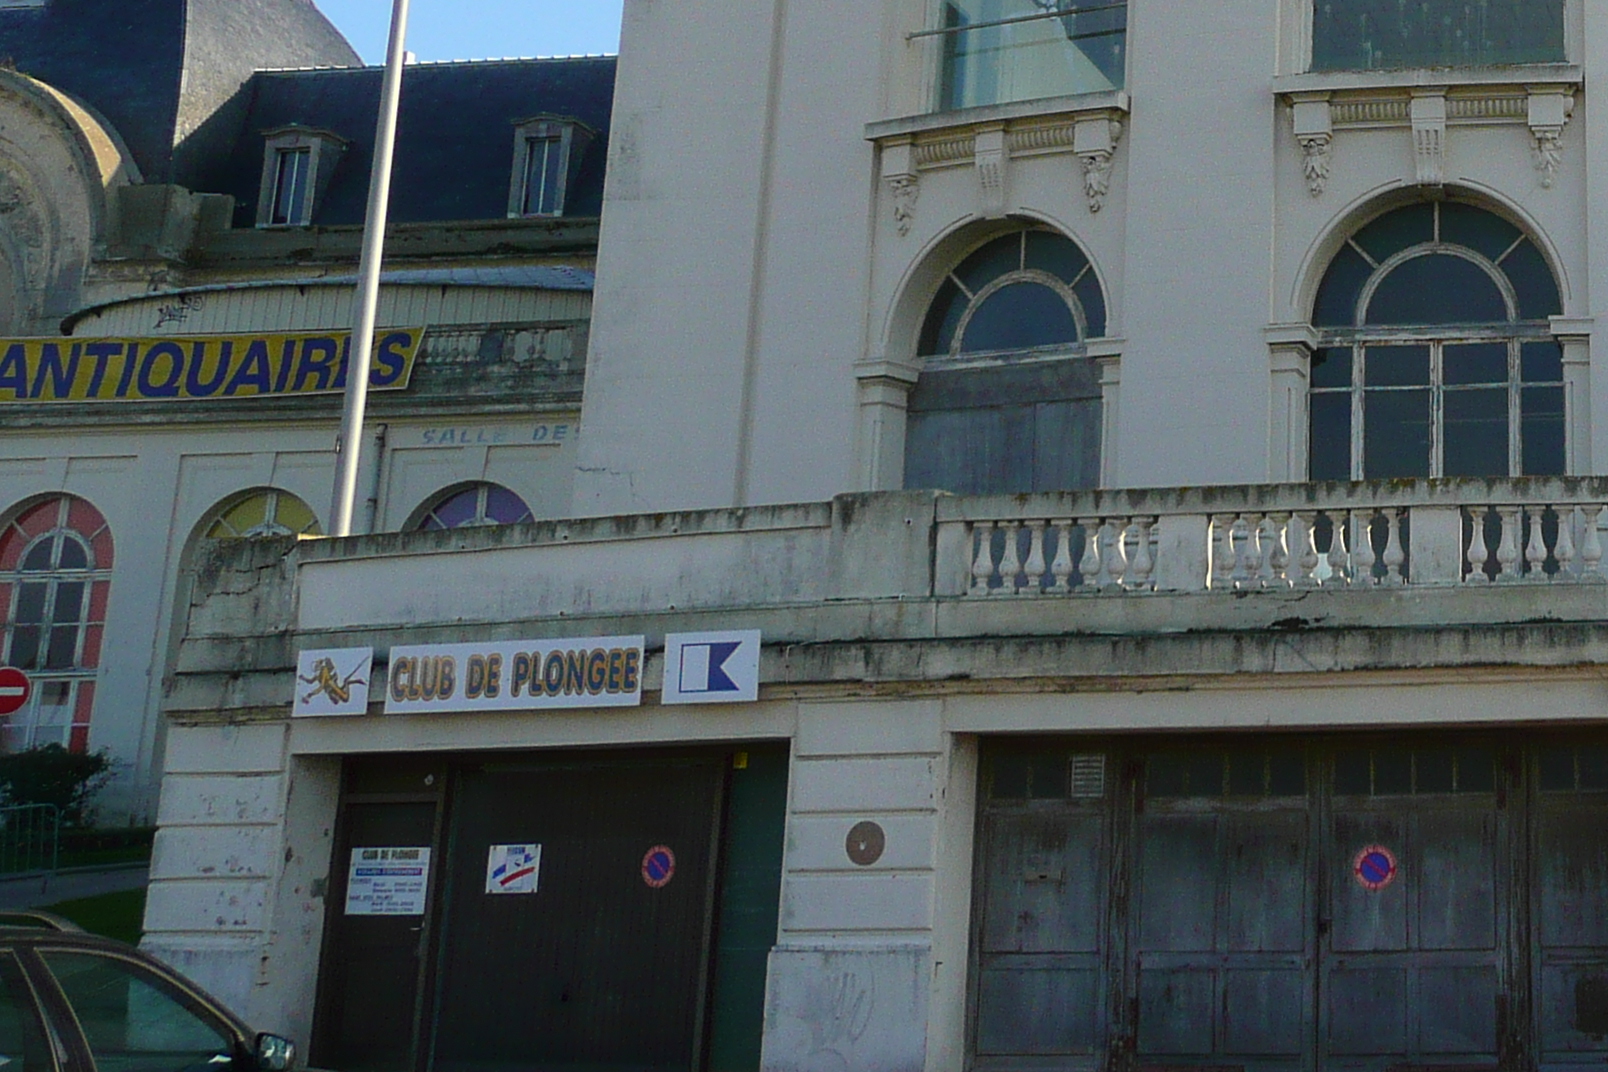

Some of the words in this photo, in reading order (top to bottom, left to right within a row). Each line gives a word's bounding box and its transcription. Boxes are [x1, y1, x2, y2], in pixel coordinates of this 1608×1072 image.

[422, 427, 507, 445] SALLE
[389, 655, 457, 702] CLUB
[465, 652, 502, 699] DE
[511, 647, 641, 697] PLONGEE
